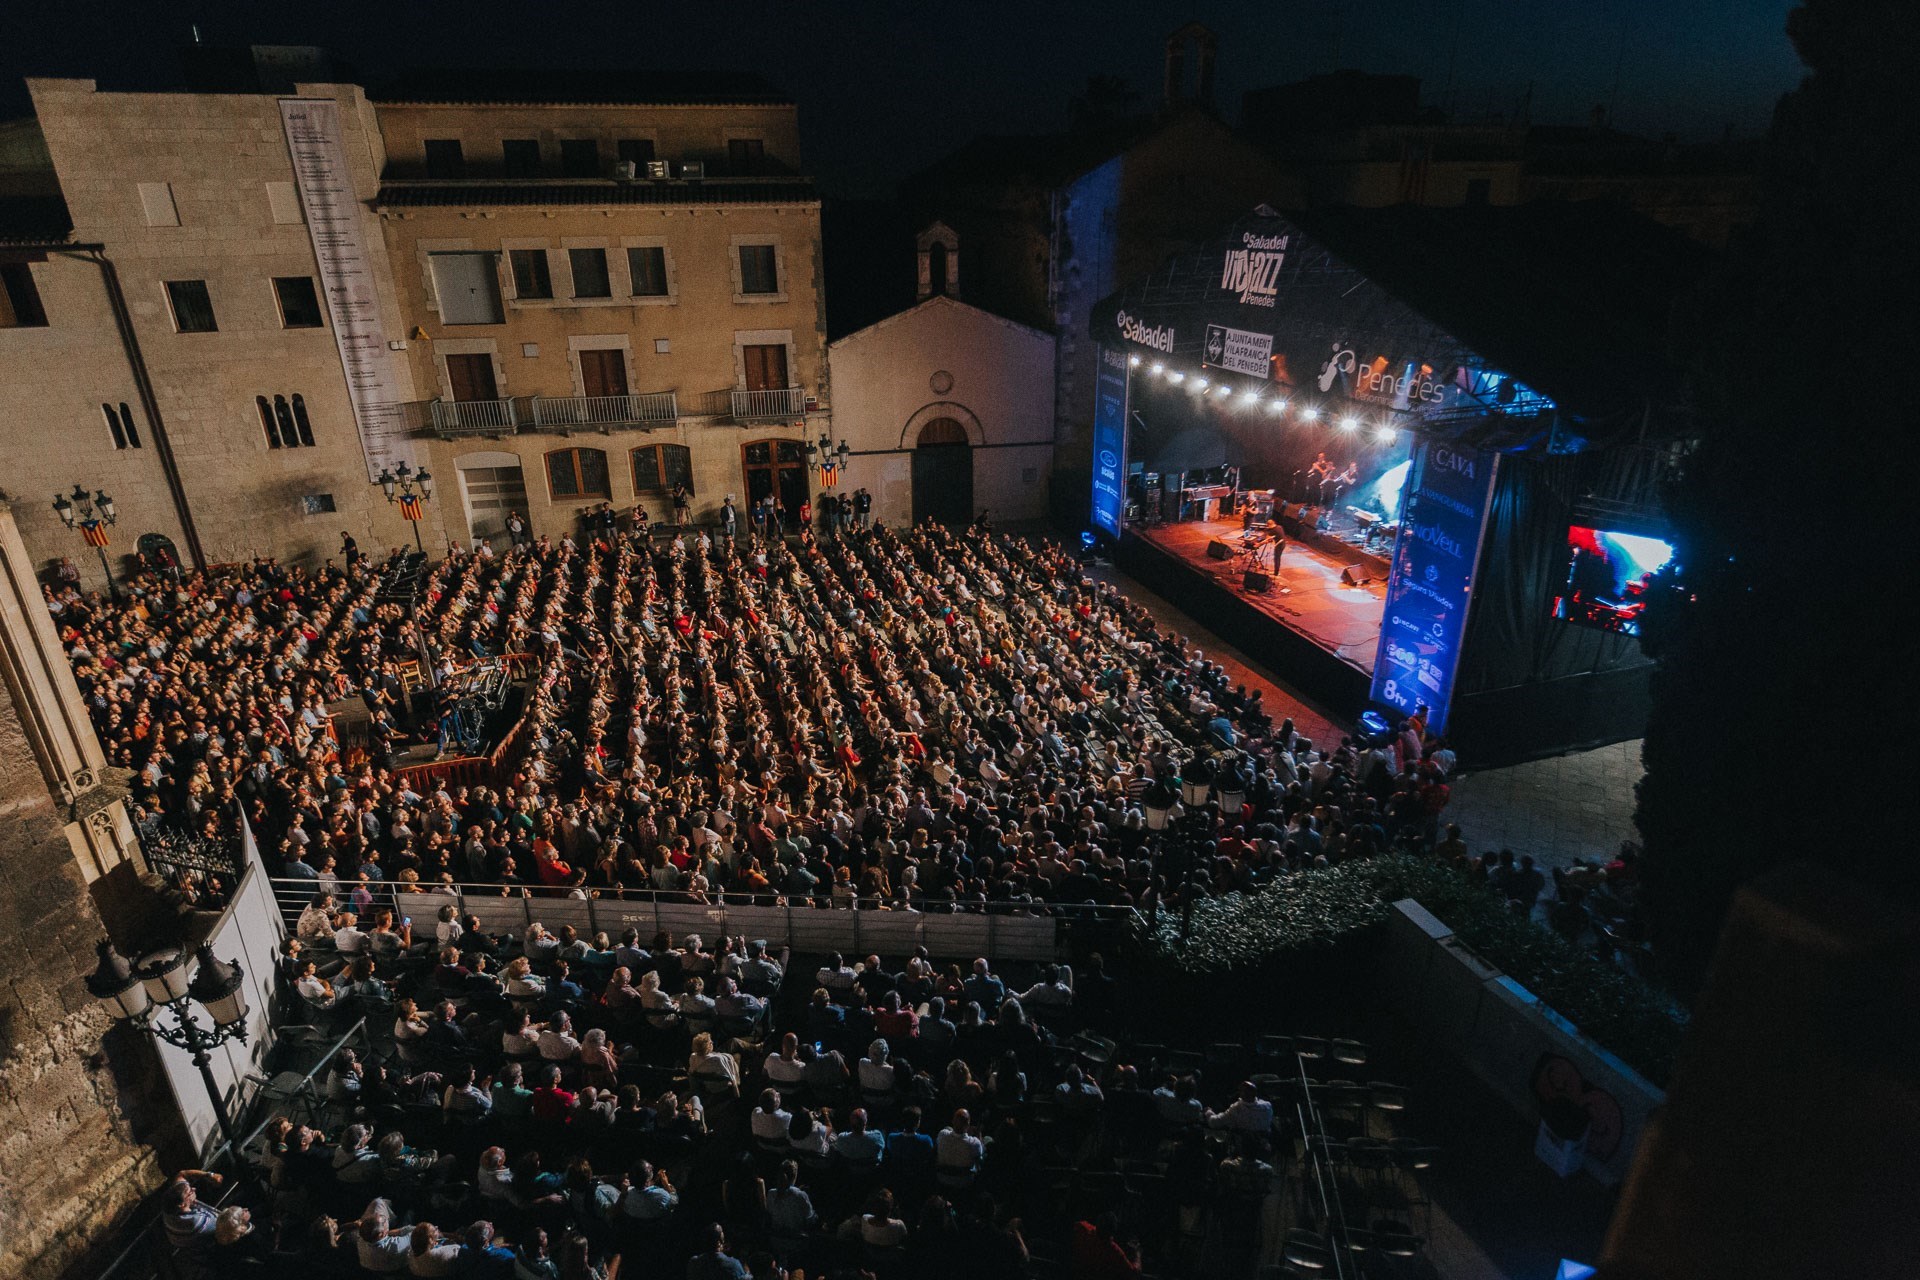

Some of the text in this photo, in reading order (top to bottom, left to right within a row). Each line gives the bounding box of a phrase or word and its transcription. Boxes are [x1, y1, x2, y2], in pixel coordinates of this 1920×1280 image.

[1247, 234, 1289, 250] Sabadell
[1245, 292, 1276, 308] Penedès
[1122, 315, 1175, 353] Sabadell
[1226, 333, 1271, 349] AJUNTAMENT
[1224, 356, 1236, 367] DEL
[1225, 344, 1268, 362] VILAFRANCA
[1356, 363, 1445, 403] Penedès
[1436, 449, 1475, 479] CAVA
[1402, 578, 1428, 595] Segura
[1383, 679, 1408, 707] 8tv
